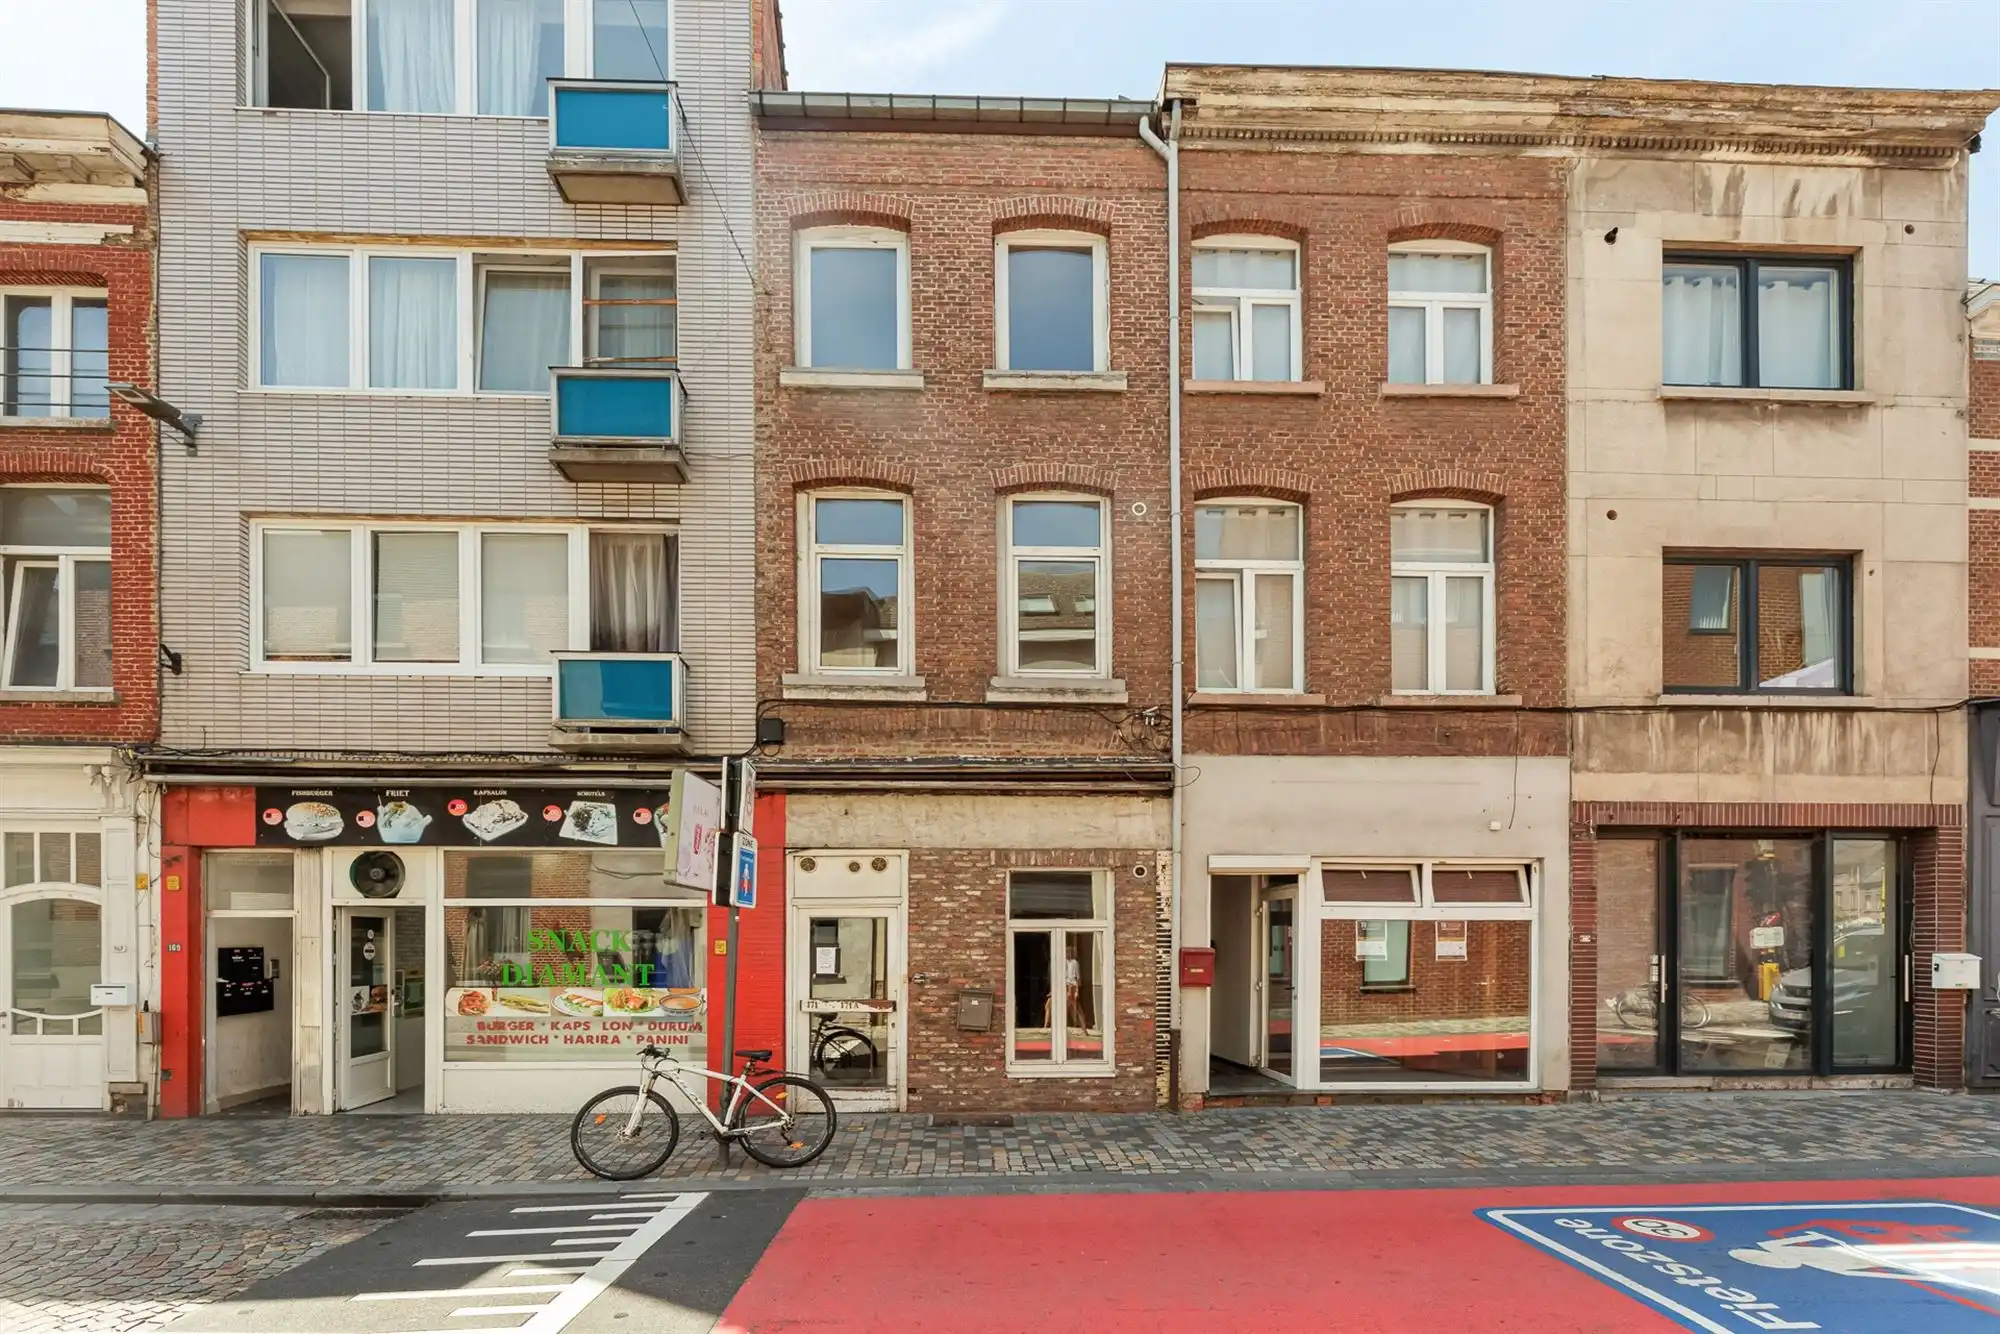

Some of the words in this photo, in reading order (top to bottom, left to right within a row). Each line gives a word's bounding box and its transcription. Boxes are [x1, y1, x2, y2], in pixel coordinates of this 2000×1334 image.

[386, 789, 410, 797] FRIET
[168, 943, 181, 951] 169
[526, 928, 633, 953] SNACK
[501, 963, 656, 987] DIAMANT
[476, 1020, 536, 1031] BURGER
[550, 1020, 591, 1031] KAPS
[602, 1020, 634, 1031] LON
[647, 1020, 704, 1033] DURUM
[466, 1034, 549, 1045] SANDWICH
[563, 1034, 621, 1045] HARIRA
[636, 1034, 690, 1045] PANINI
[1631, 1218, 1689, 1239] 30
[1554, 1217, 1823, 1331] Fietszone
